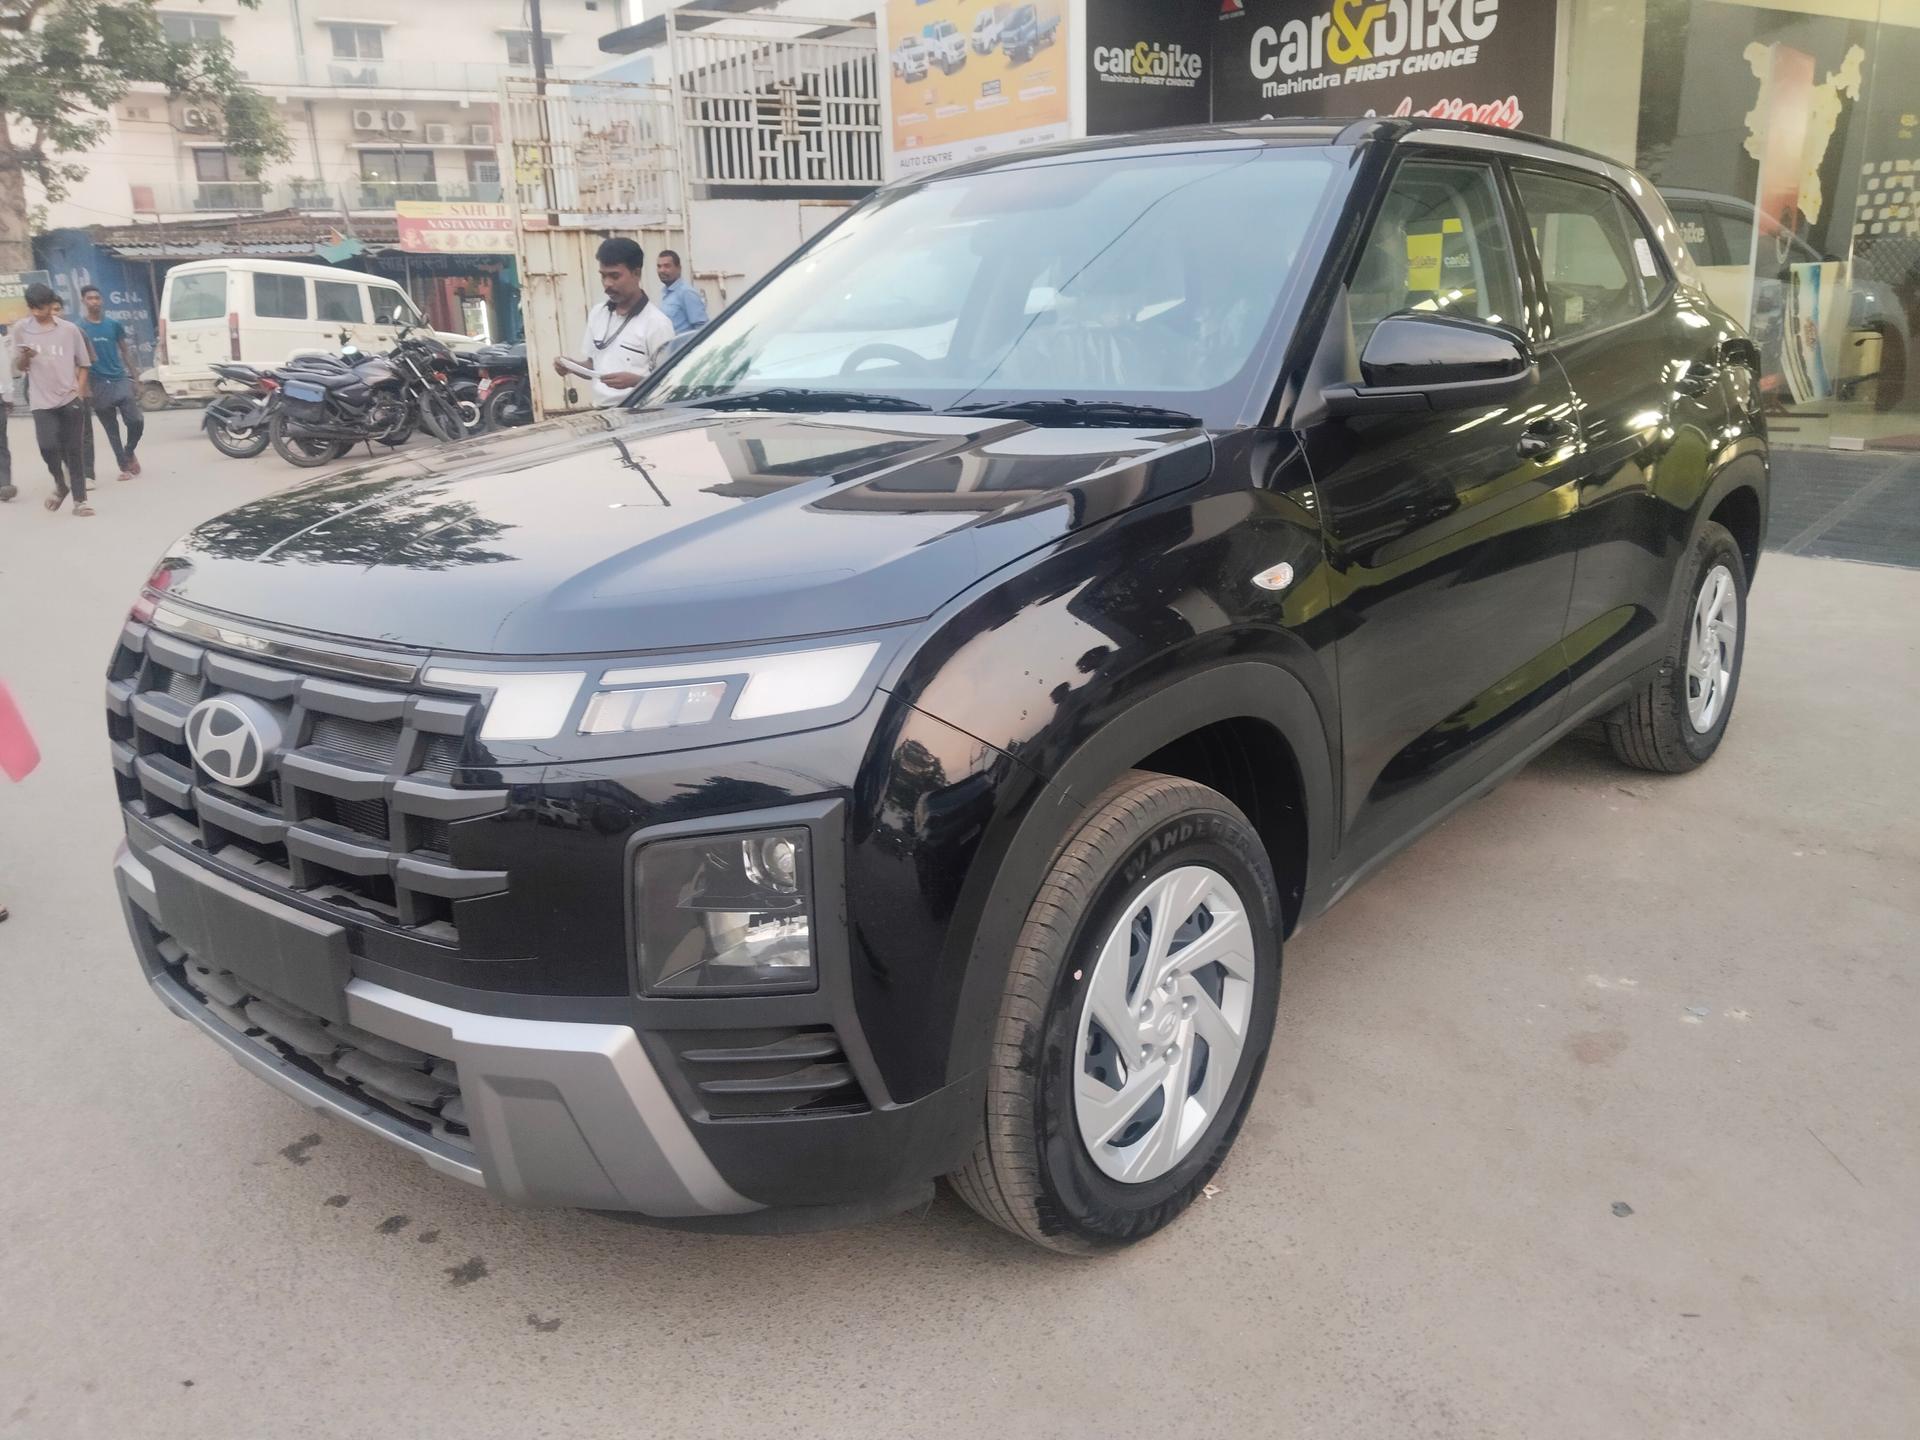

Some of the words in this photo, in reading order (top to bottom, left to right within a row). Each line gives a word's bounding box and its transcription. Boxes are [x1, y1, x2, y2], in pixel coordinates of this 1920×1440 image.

[1094, 41, 1202, 78] car&bike
[1250, 0, 1498, 79] car&bike
[1262, 73, 1341, 98] Mahindra
[1343, 59, 1400, 84] FIRST
[1402, 44, 1480, 75] CHOICE
[900, 157, 921, 168] AUTO
[922, 151, 953, 165] CENTRE
